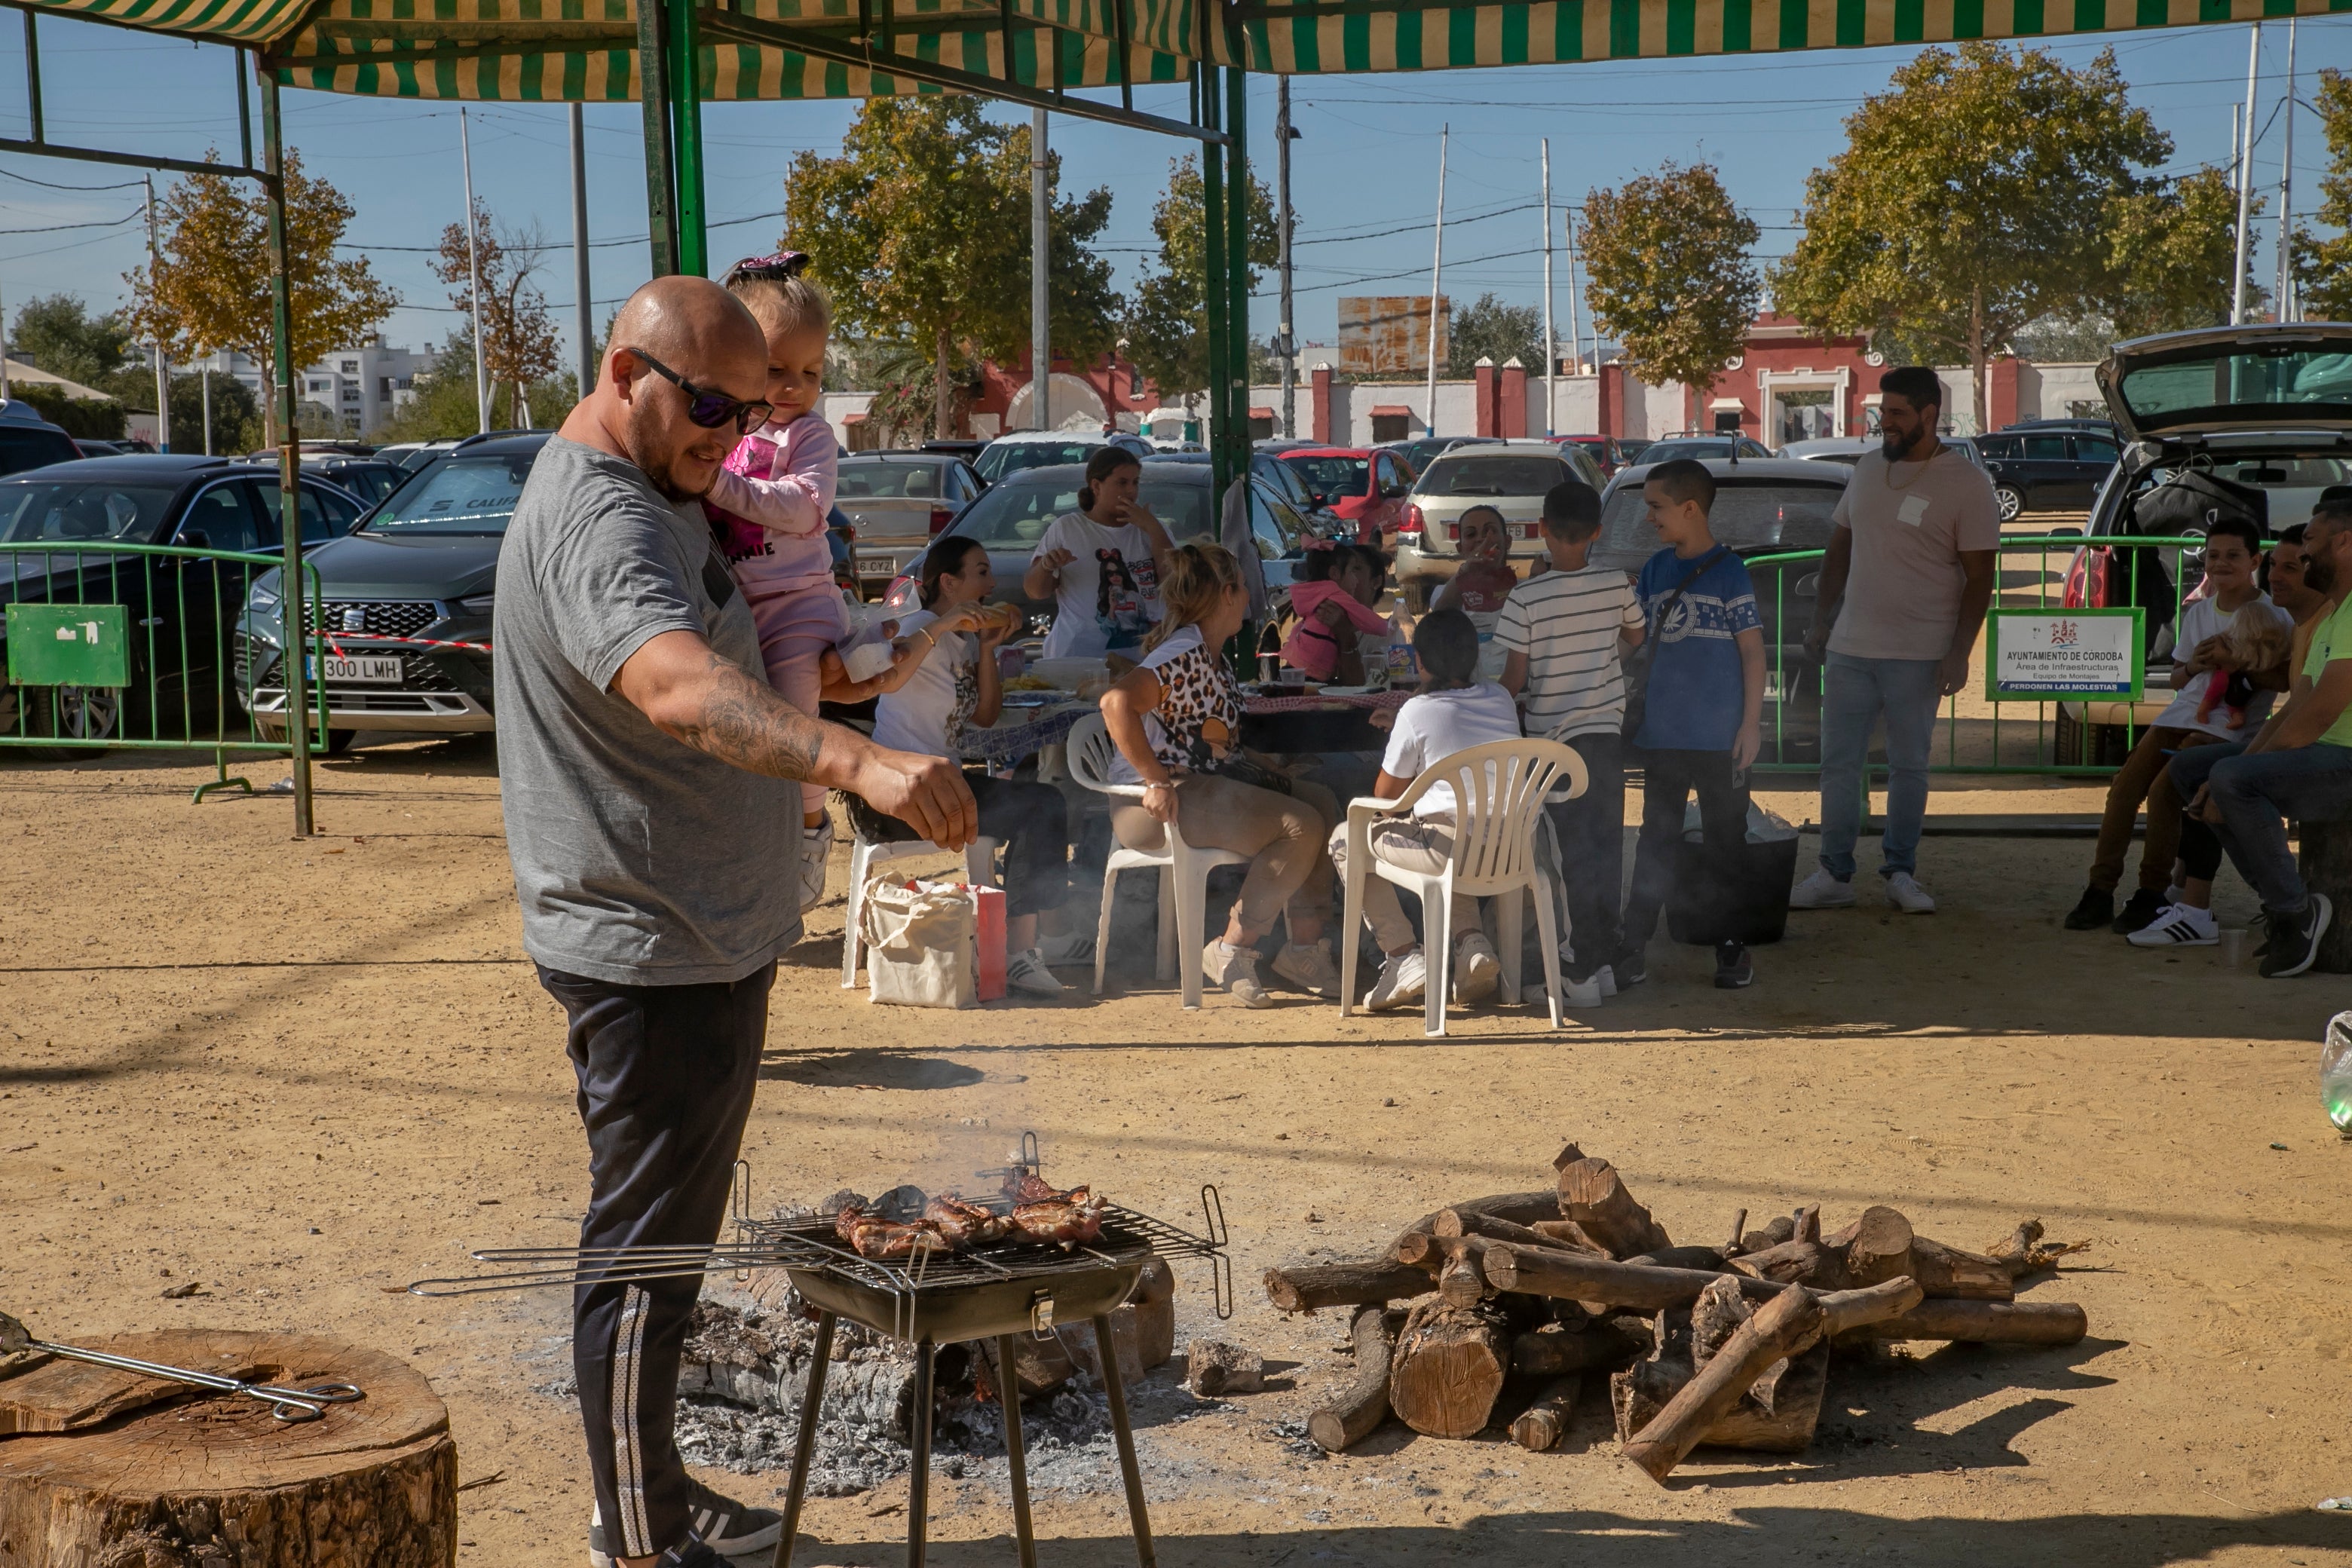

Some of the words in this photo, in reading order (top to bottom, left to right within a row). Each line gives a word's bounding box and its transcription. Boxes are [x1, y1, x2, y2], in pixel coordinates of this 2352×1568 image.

[725, 542, 775, 565] NNIE
[870, 562, 890, 571] CYZ
[2007, 651, 2068, 661] AYUNTAMIENTO
[2070, 652, 2081, 660] DE
[2083, 650, 2124, 661] CÓRDOBA
[315, 660, 356, 677] 300
[363, 660, 397, 678] LMH
